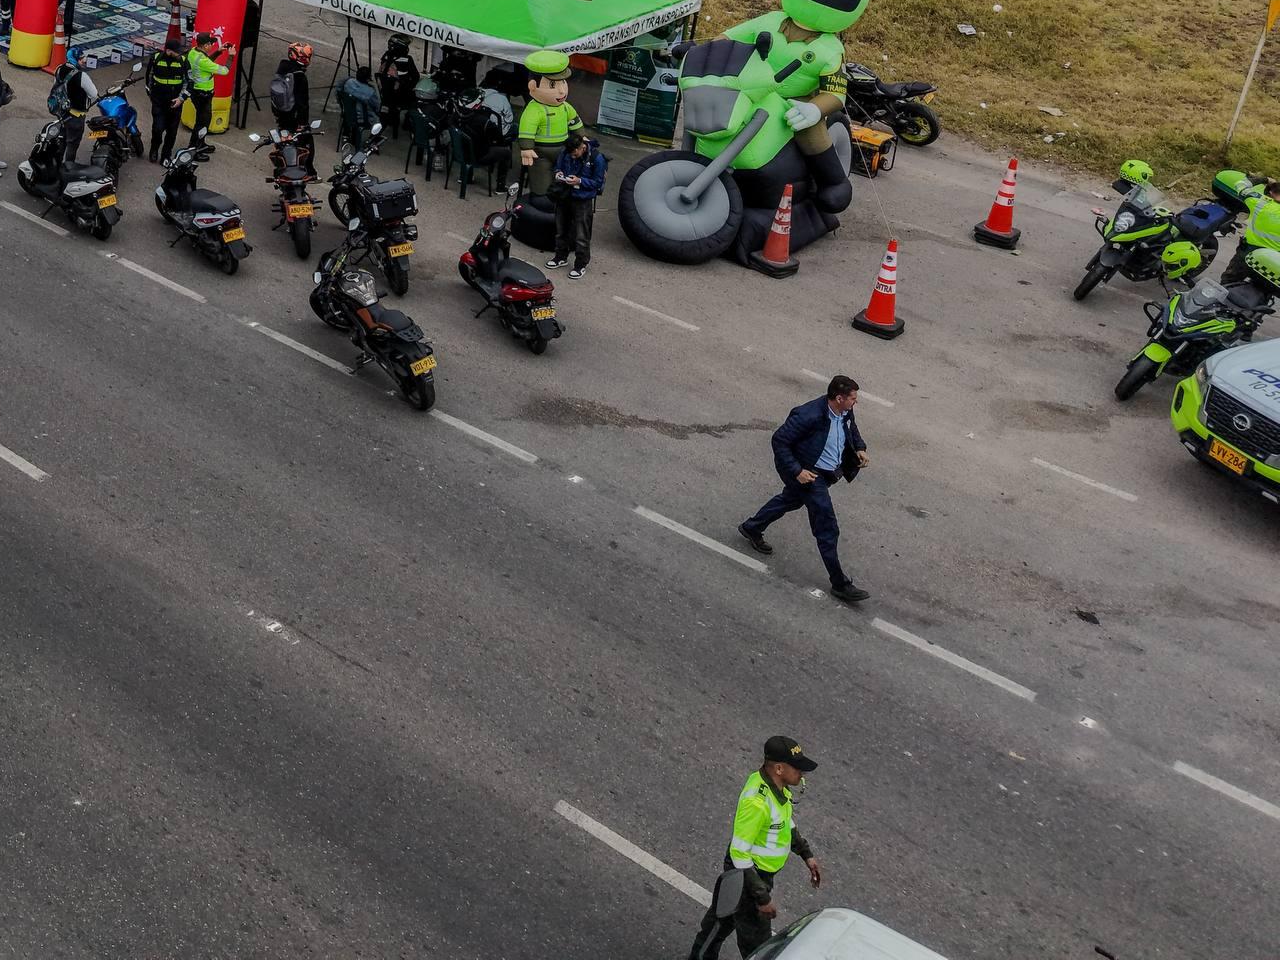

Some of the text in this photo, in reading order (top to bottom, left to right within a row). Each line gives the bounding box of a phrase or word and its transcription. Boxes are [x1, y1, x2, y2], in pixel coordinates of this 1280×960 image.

[385, 13, 465, 47] NACIONAL
[875, 282, 892, 293] DITRA
[1210, 442, 1245, 470] LVV-286
